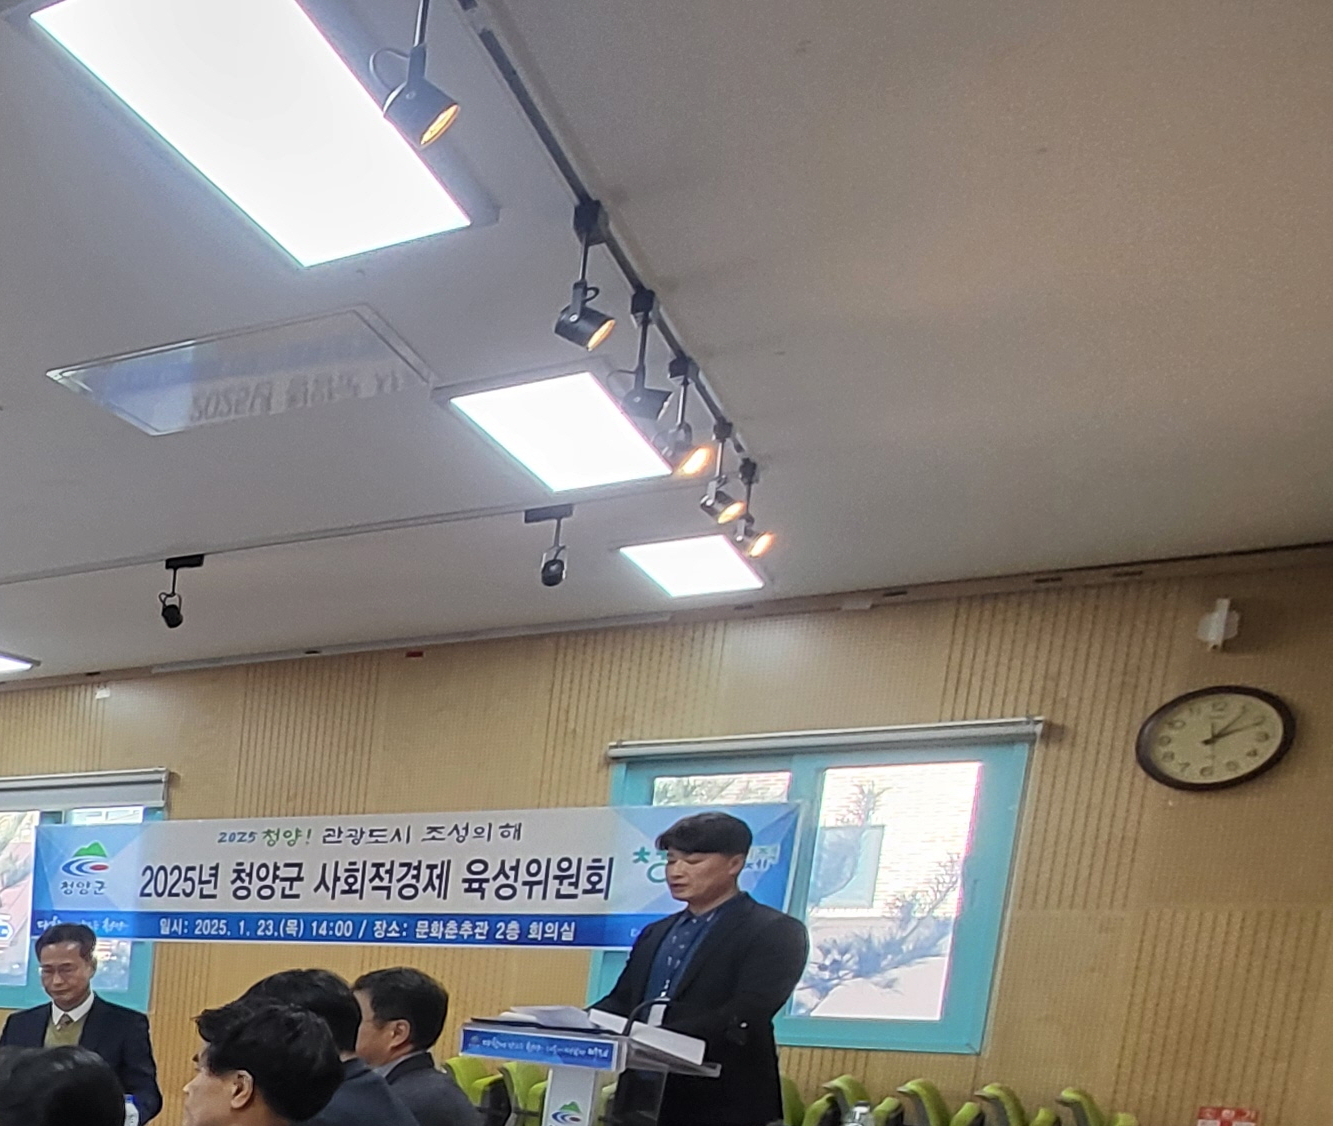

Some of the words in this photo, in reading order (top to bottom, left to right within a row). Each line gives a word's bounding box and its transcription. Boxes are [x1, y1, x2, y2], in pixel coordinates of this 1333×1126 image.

[217, 831, 258, 844] 2025
[262, 827, 313, 847] 청양!
[322, 825, 411, 846] 관광도시
[421, 822, 493, 844] 조성의
[499, 821, 523, 842] 해
[59, 879, 108, 896] 청양군
[139, 862, 220, 900] 2025년
[230, 860, 305, 901] 청양군
[312, 858, 452, 901] 사회적경제
[461, 856, 615, 901] 육성위원회
[159, 918, 190, 936] 일시:
[194, 919, 232, 936] 2025.
[238, 920, 251, 936] 1.
[257, 918, 305, 938] 23.(목)
[311, 920, 354, 938] 14:00
[357, 919, 368, 939] /
[373, 920, 408, 939] 장소:
[415, 920, 491, 940] 문화춘추관
[495, 921, 521, 940] 2층
[527, 921, 576, 941] 회의실
